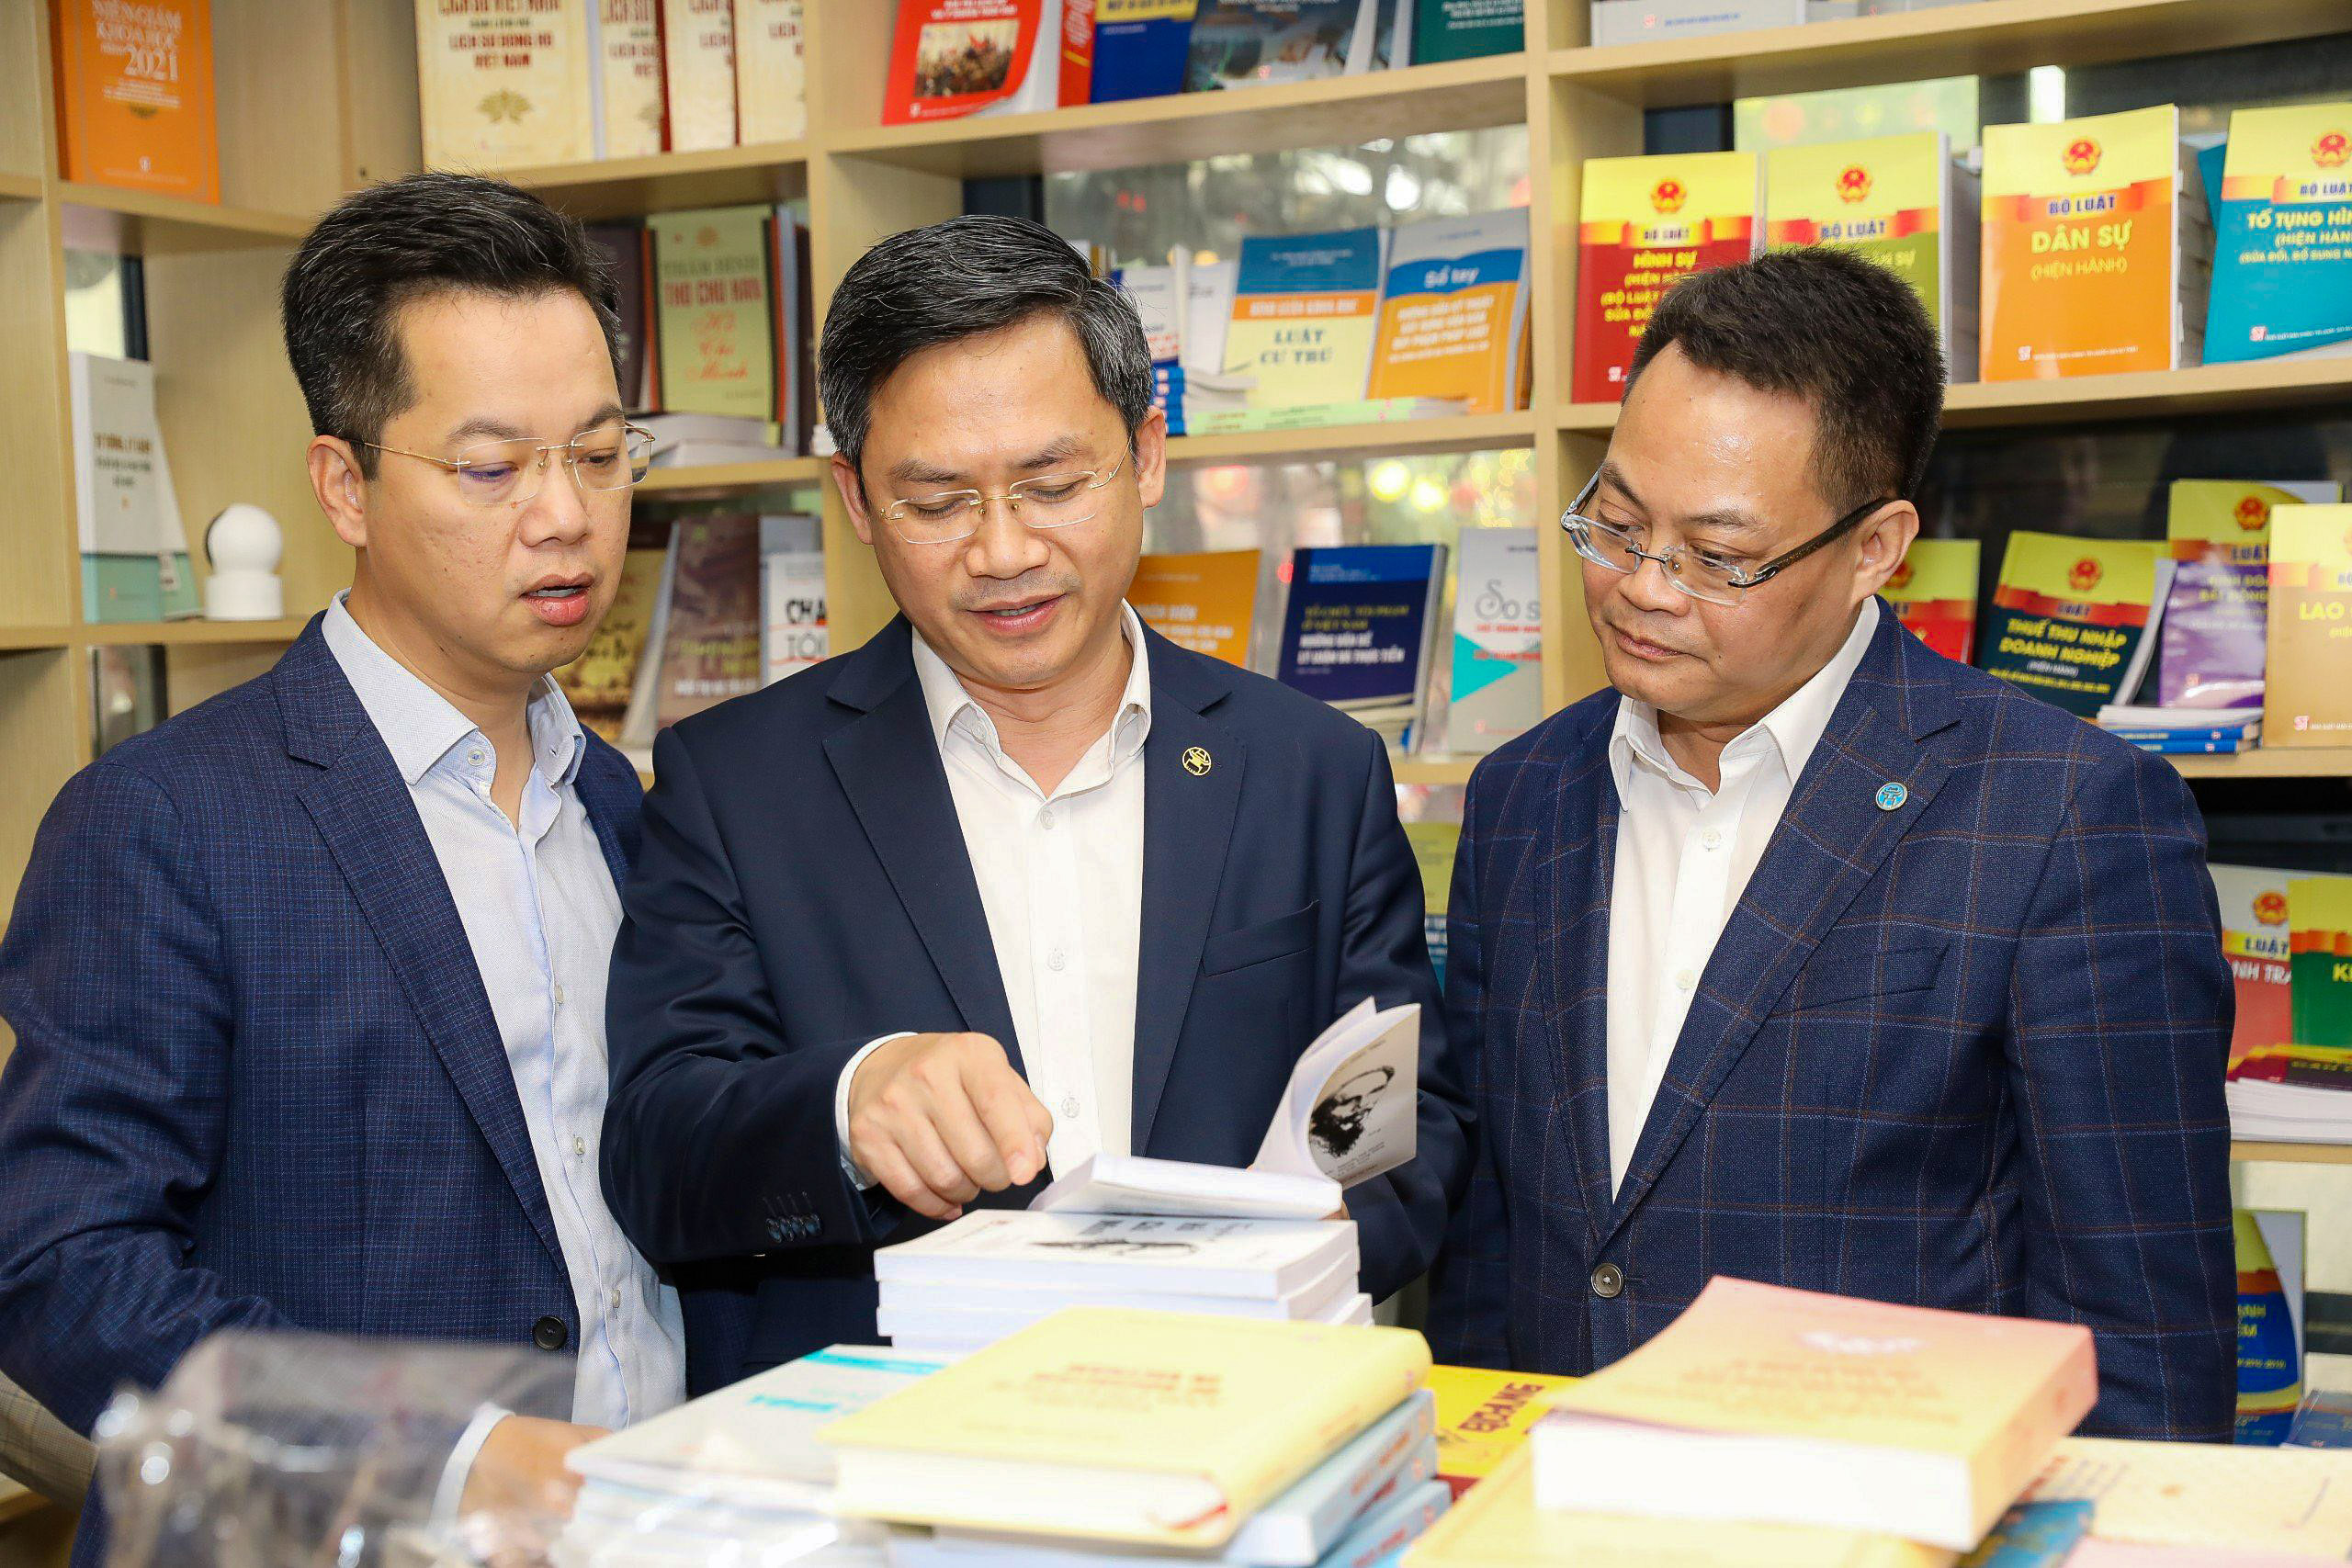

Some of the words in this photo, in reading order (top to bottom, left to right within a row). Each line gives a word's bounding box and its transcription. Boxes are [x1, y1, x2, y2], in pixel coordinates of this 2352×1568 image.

[124, 44, 178, 81] 2021
[2050, 199, 2071, 215] BỘ
[2076, 195, 2116, 212] LUẬT
[1848, 220, 1885, 238] LUẬT
[2247, 208, 2273, 229] TỐ
[2275, 211, 2324, 231] TỤNG
[2031, 224, 2090, 254] DÂN
[2098, 219, 2133, 252] SỰ
[2299, 601, 2346, 621] LAO
[2007, 618, 2052, 638] THUẾ
[2048, 624, 2079, 643] THU
[2079, 629, 2128, 649] NHẬP
[1999, 637, 2060, 660] DOANH
[2059, 648, 2120, 671] NGHIỆP
[2245, 937, 2289, 958] LUẬT
